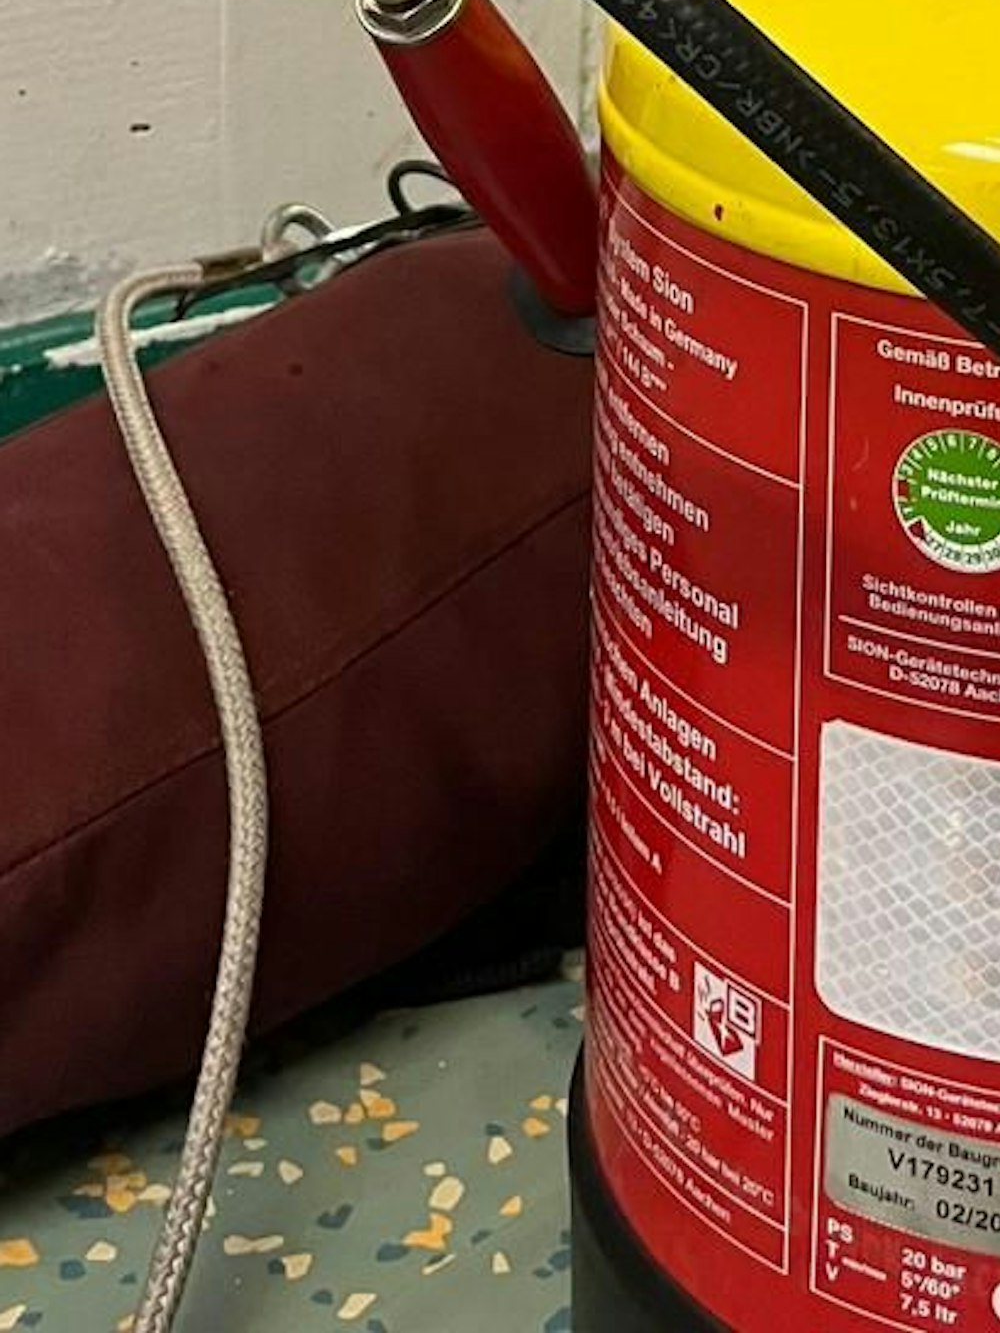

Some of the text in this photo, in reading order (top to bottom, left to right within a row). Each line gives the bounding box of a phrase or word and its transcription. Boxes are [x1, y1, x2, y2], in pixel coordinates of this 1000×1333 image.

[652, 265, 695, 315] Sion
[664, 318, 738, 380] Germany
[876, 338, 951, 371] Gemäß
[944, 520, 983, 538] Jahr
[649, 546, 739, 630] Personal
[861, 572, 998, 618] Sichtkontrollen
[888, 664, 961, 696] D-52078
[639, 679, 717, 762] Anlagen
[647, 761, 746, 859] Vollstrahl
[842, 1107, 912, 1144] Nummer
[915, 1134, 943, 1157] der
[848, 1172, 916, 1211] Baujahr:
[887, 1146, 995, 1197] V179231
[827, 1217, 854, 1244] PS
[825, 1261, 840, 1282] V
[900, 1246, 927, 1269] 20
[930, 1255, 967, 1280] bar
